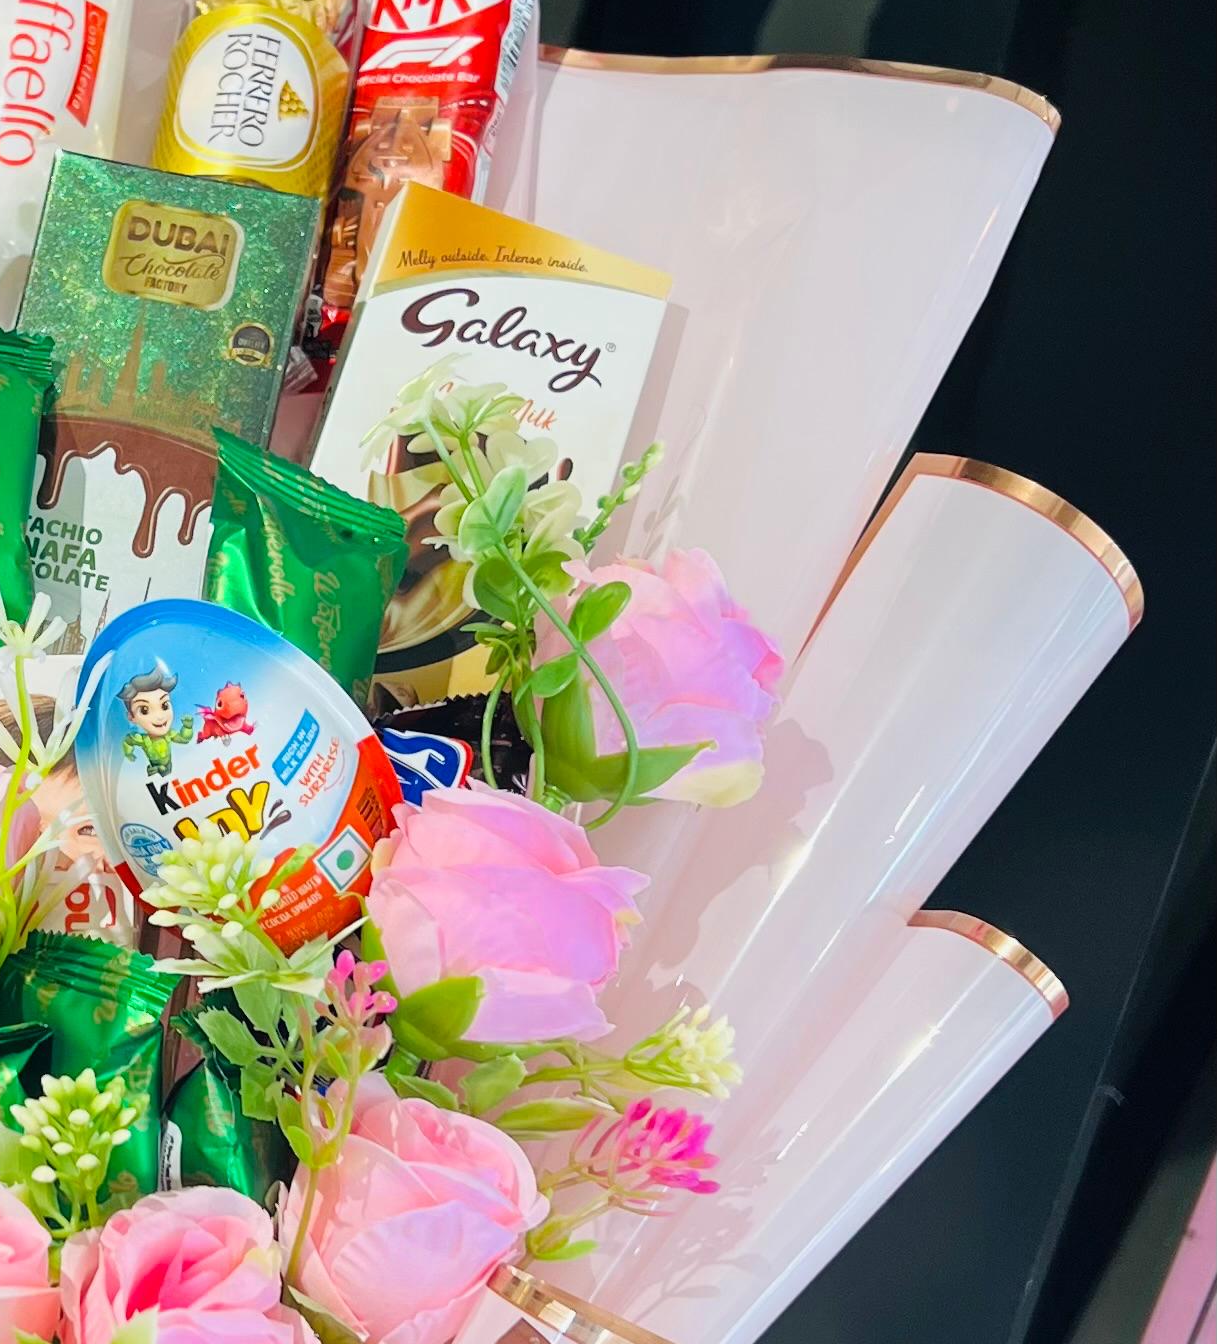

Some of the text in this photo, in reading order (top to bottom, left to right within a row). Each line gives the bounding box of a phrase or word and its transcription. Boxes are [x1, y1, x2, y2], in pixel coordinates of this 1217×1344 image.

[208, 33, 253, 143] ROCHER
[237, 34, 281, 148] FERRERO
[357, 71, 481, 86] fficial Chocolate Bar
[127, 215, 230, 257] DUBAI
[118, 253, 226, 281] Chocolate
[495, 246, 543, 265] Intense
[143, 276, 188, 295] FACTORY
[401, 288, 602, 394] Galaxy
[28, 514, 103, 545] ACHIO
[31, 560, 110, 592] OLATE
[312, 571, 341, 670] Wafero
[298, 753, 325, 787] WITH
[299, 736, 339, 807] SURPRISE
